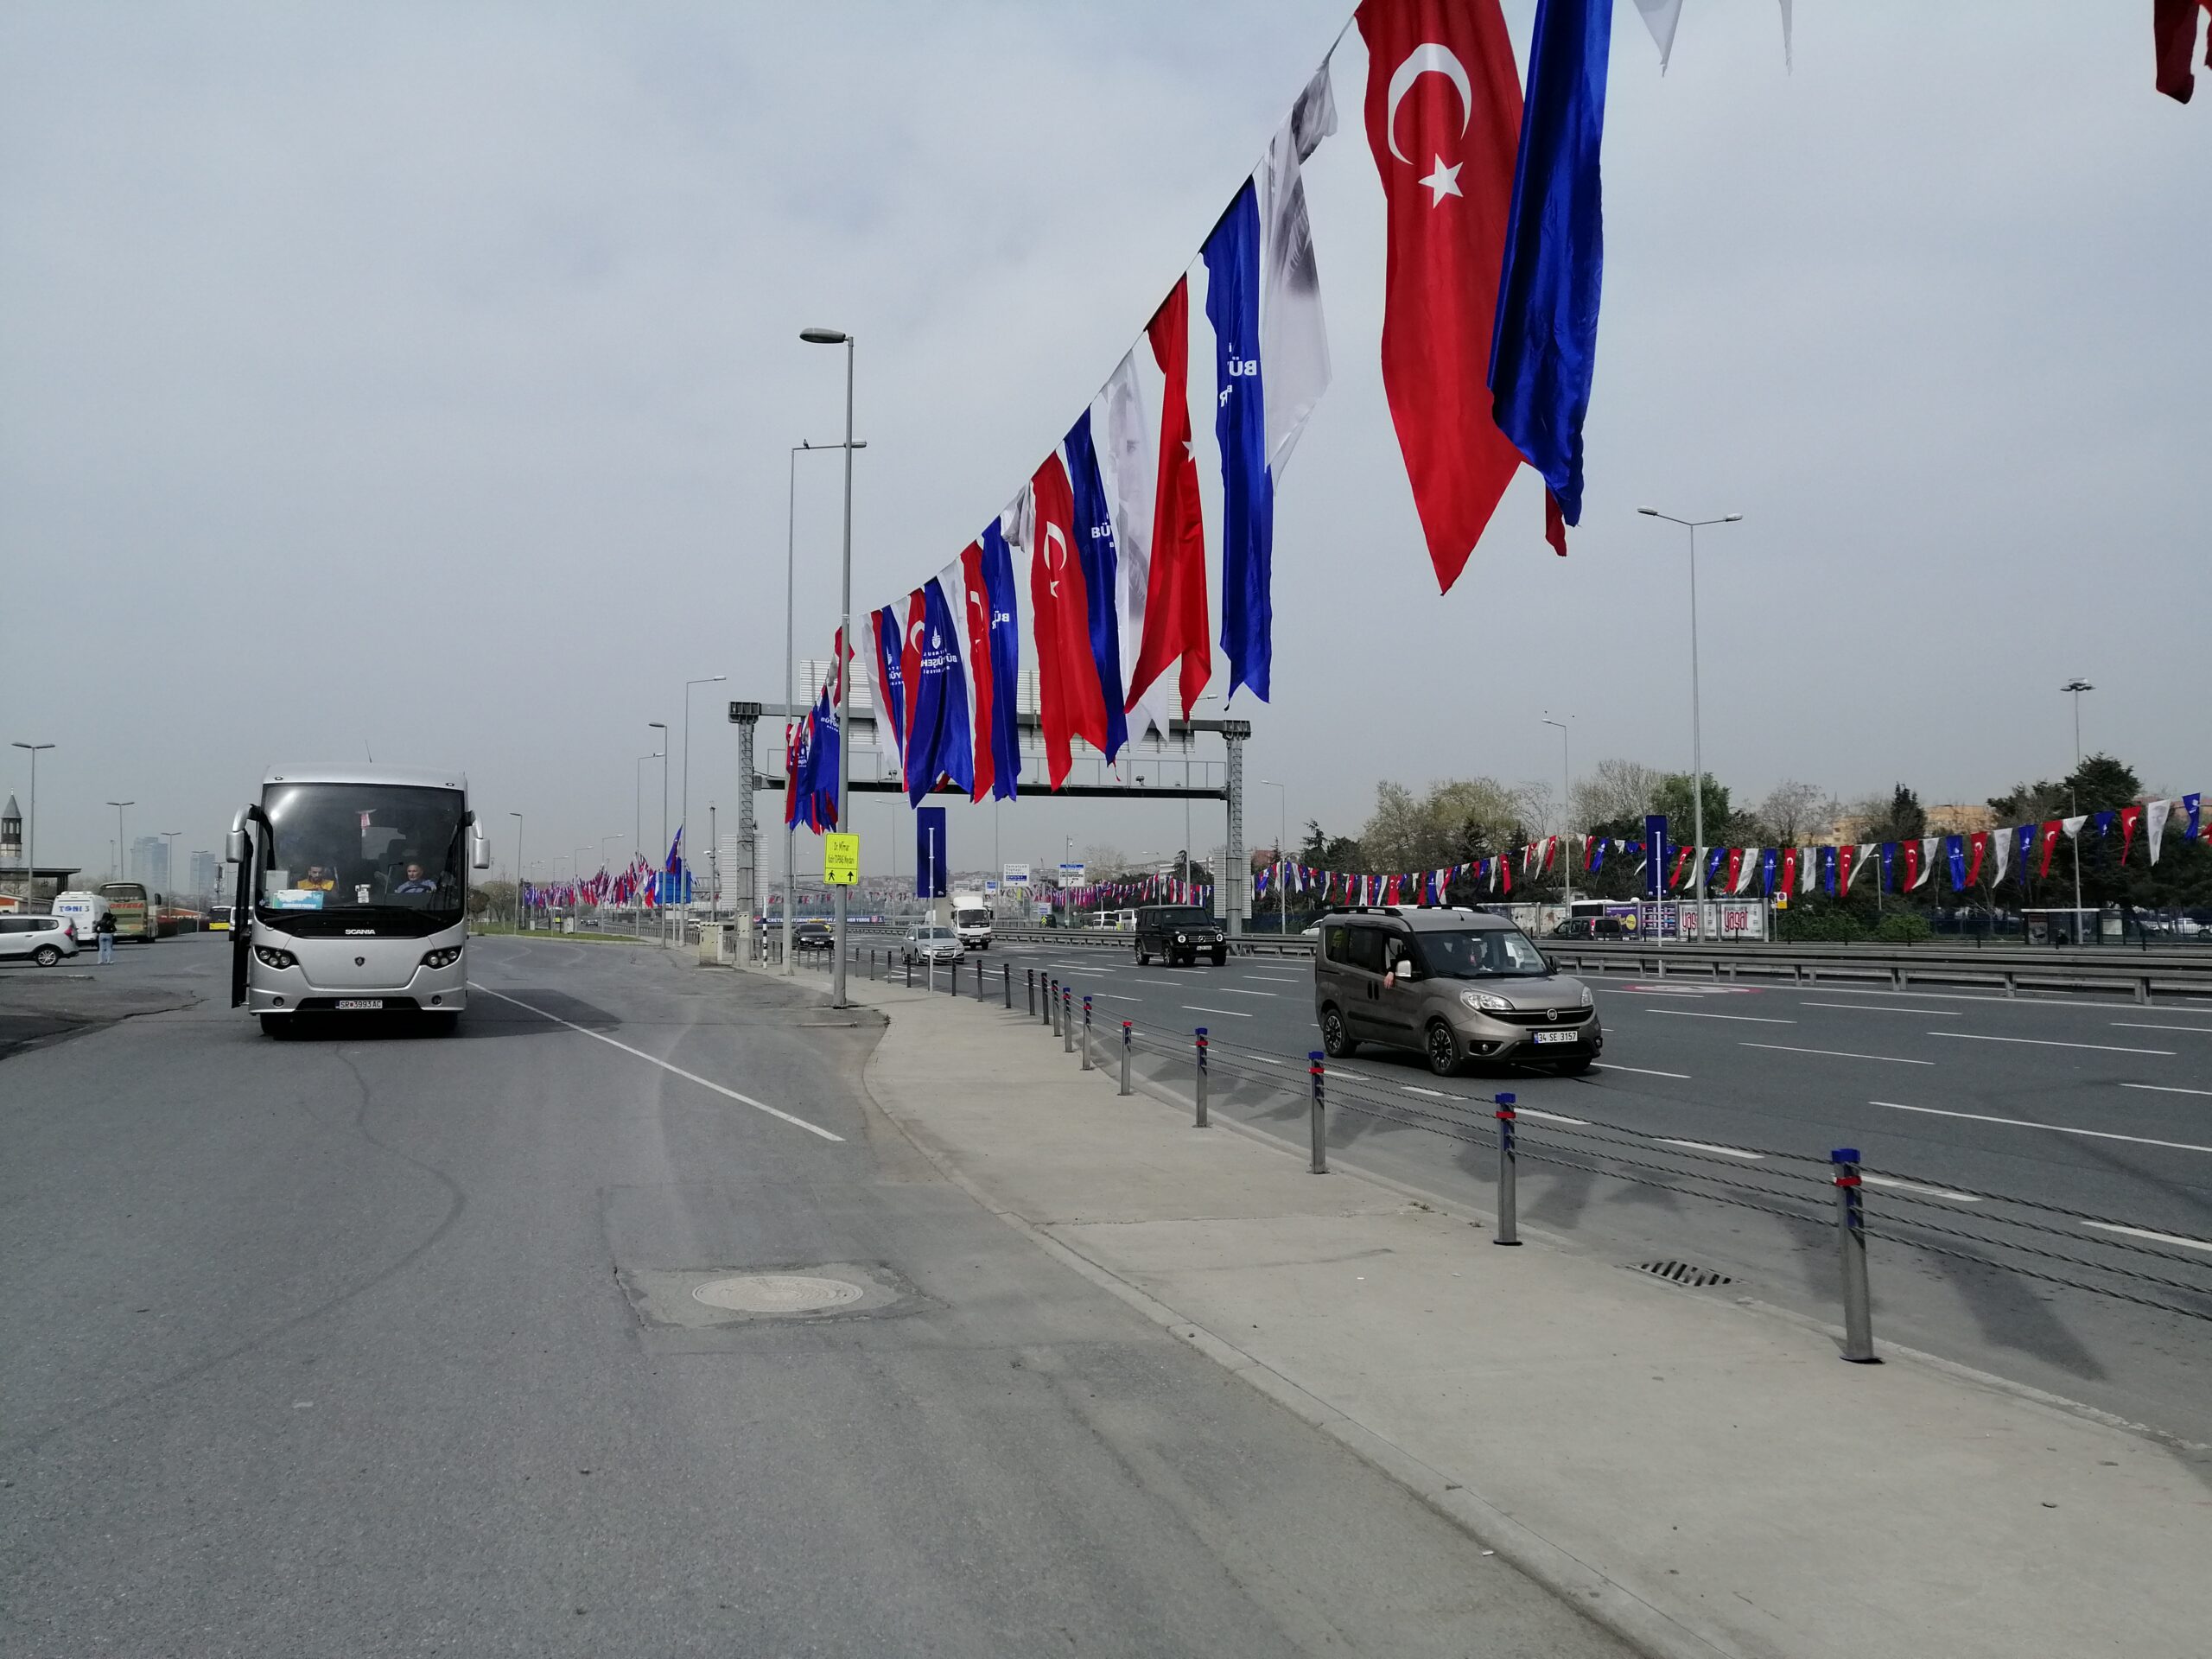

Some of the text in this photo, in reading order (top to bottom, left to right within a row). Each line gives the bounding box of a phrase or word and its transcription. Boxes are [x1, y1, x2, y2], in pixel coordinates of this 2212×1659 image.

[1539, 1032, 1577, 1042] 34 SE 3157
